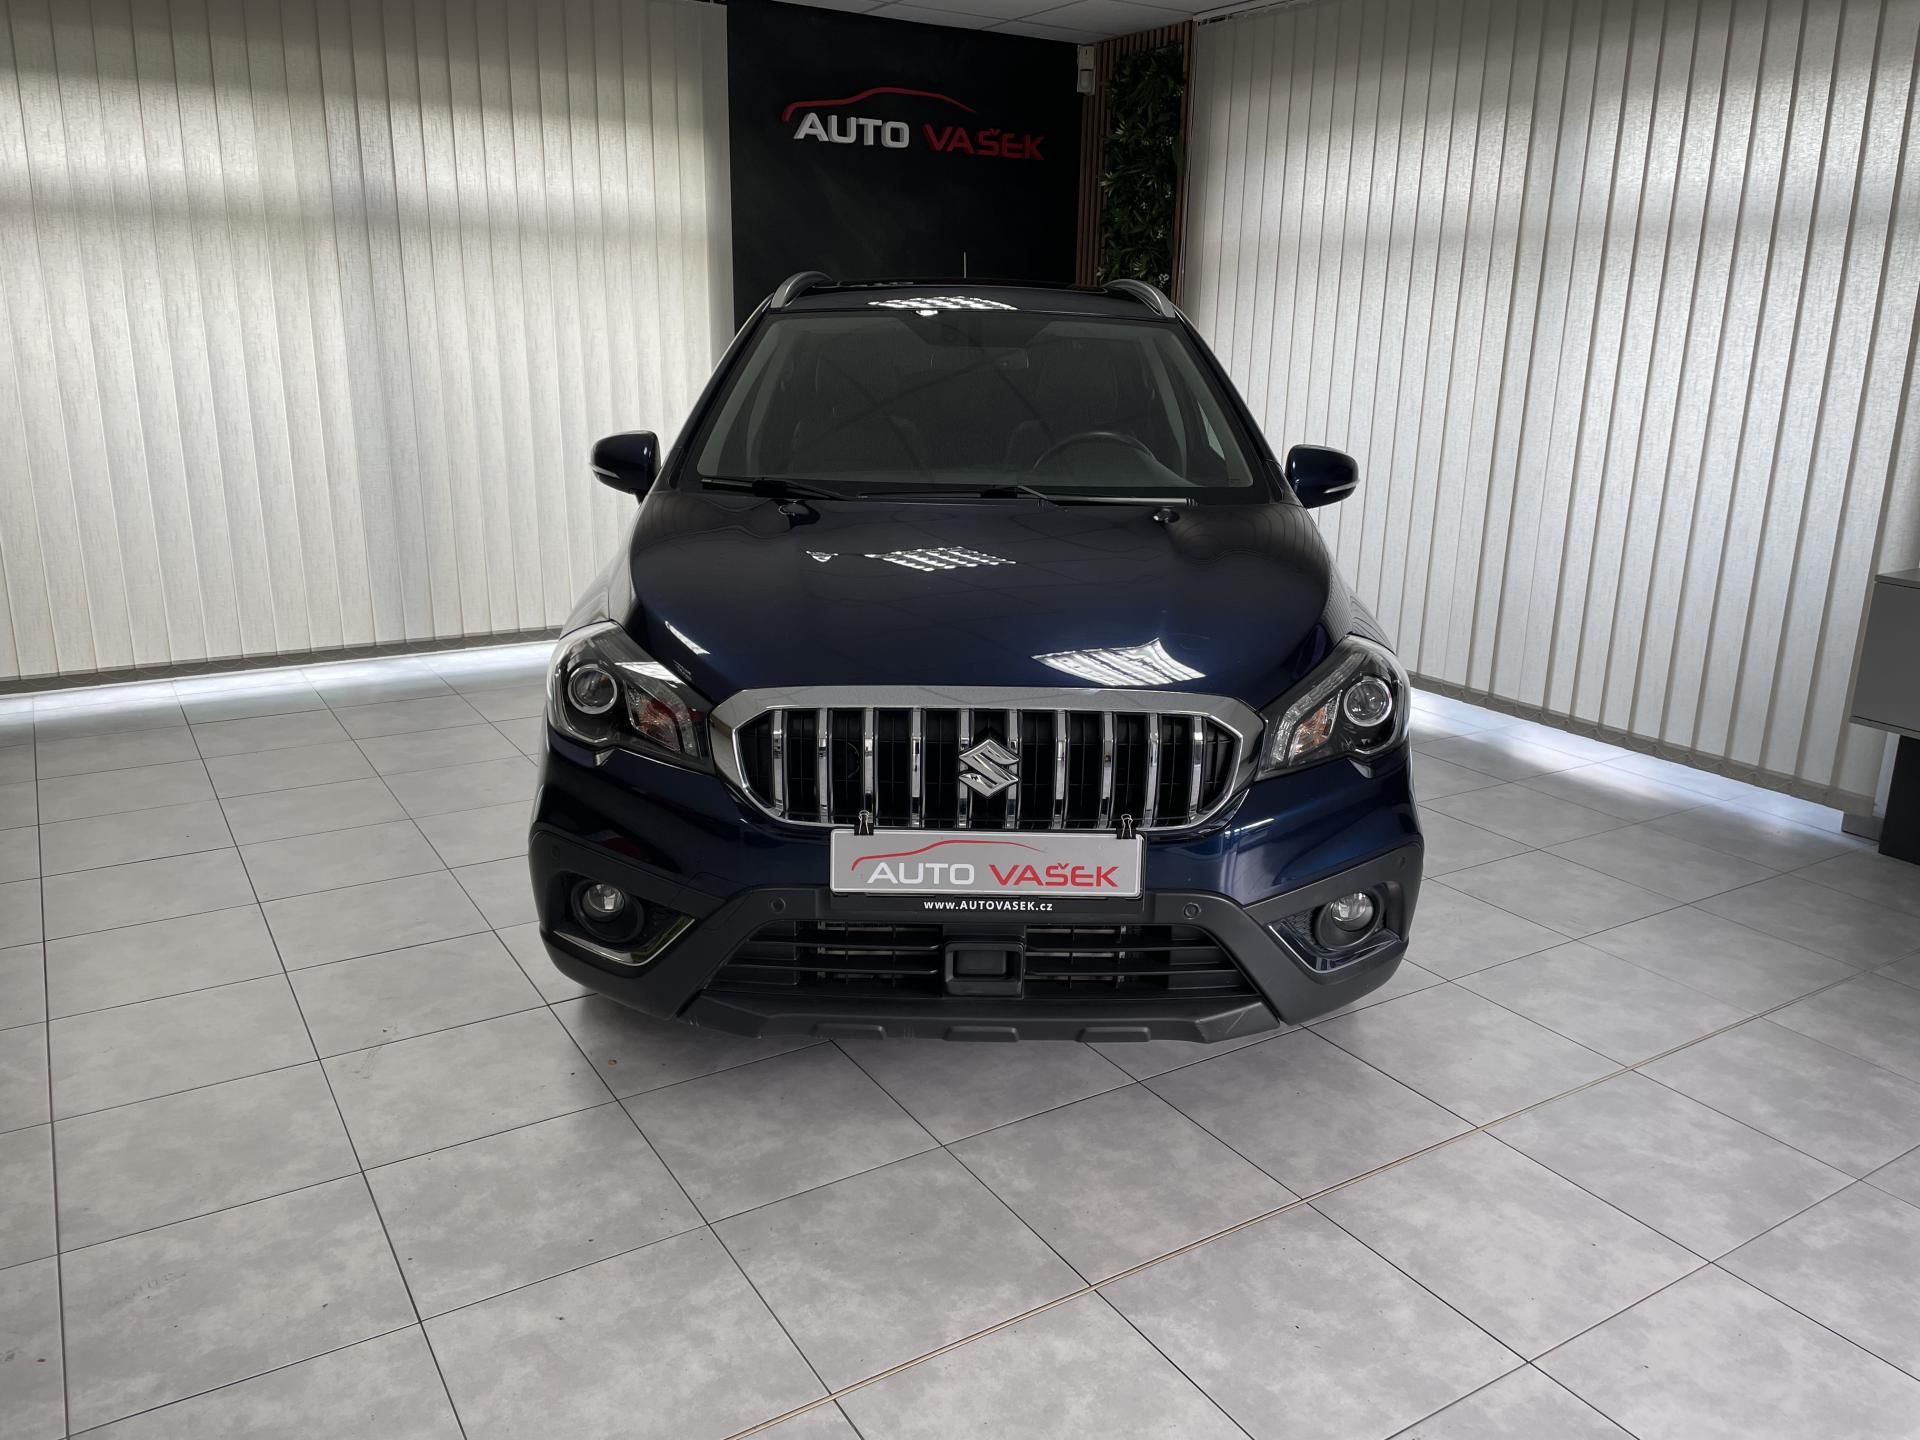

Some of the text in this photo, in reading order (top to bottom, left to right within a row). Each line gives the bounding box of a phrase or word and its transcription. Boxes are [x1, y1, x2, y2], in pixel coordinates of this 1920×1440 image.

[794, 112, 1046, 161] AUTO VAŠEK
[867, 862, 1120, 887] AUTO VAŠEK
[923, 900, 1054, 912] www.AUTOVASEK.cz
